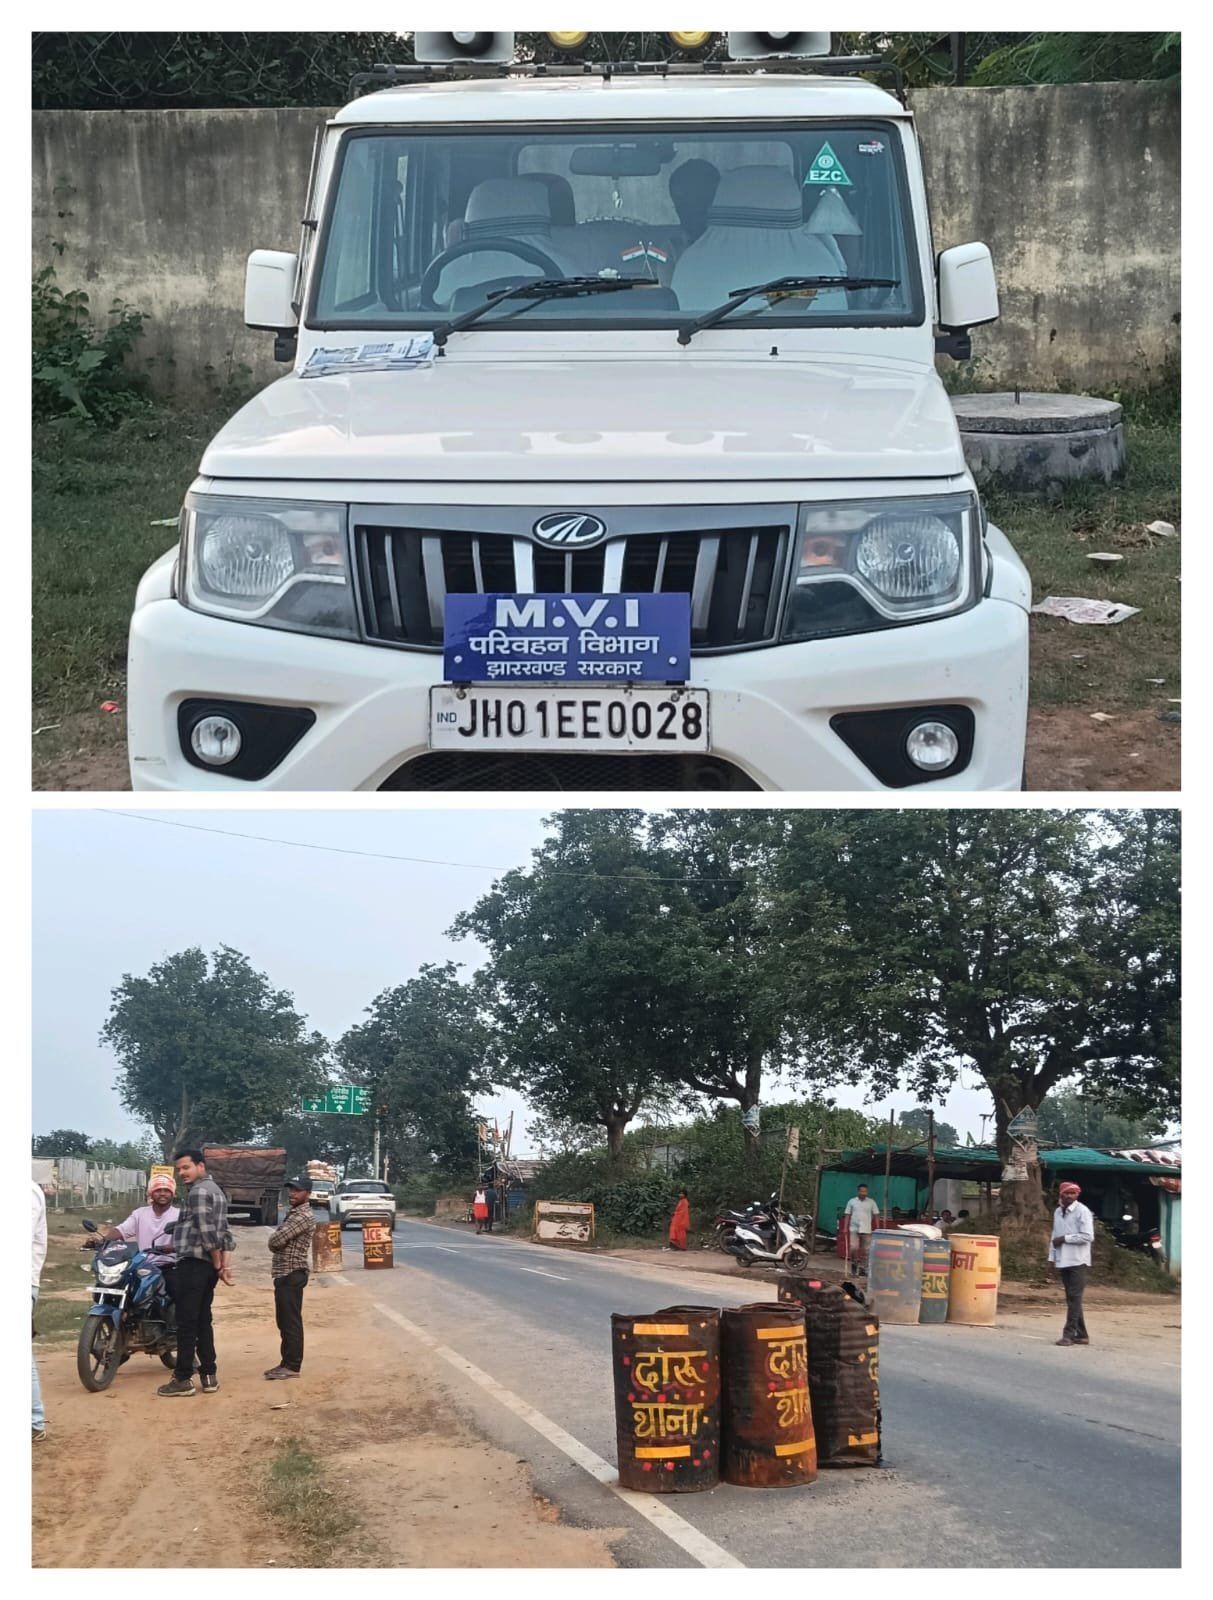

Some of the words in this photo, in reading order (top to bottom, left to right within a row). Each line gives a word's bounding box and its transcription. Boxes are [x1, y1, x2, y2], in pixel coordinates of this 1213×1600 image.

[809, 170, 842, 181] EZC
[495, 598, 639, 628] M.V.I
[468, 629, 570, 655] परिवहन
[578, 629, 660, 655] विभाग
[486, 660, 568, 679] झारखण्ड
[577, 660, 643, 676] सरकार
[436, 711, 457, 723] IND
[458, 699, 702, 740] JH01EE0028
[631, 1402, 704, 1438] थाना
